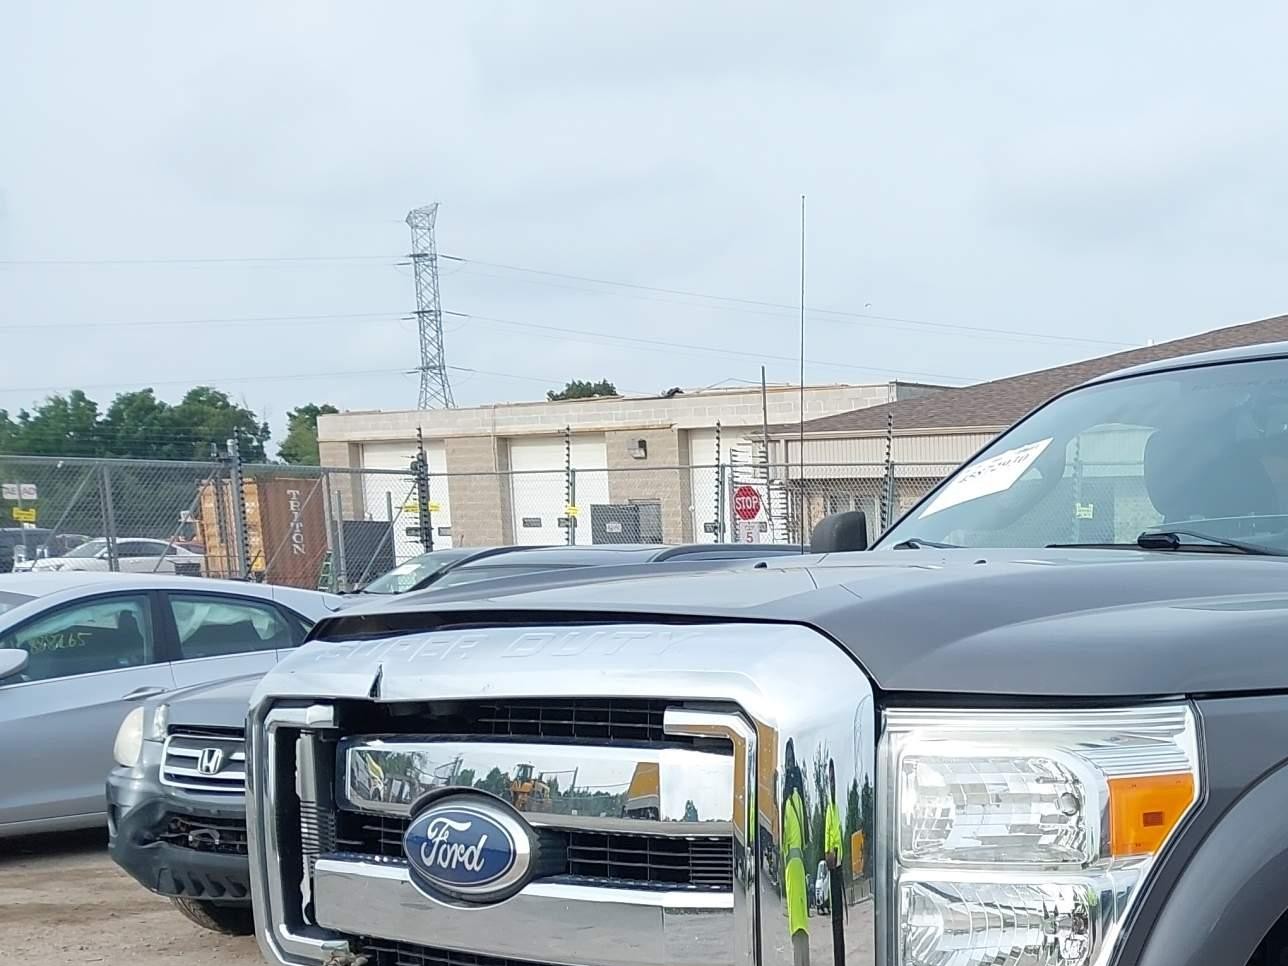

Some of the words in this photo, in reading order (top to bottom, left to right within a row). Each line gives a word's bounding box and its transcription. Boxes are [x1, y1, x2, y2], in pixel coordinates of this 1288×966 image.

[735, 495, 759, 510] STOP
[286, 489, 306, 554] TRITON
[746, 531, 754, 543] 5
[314, 633, 489, 662] SUPER
[500, 631, 702, 657] DUTY
[421, 817, 487, 872] Ford
